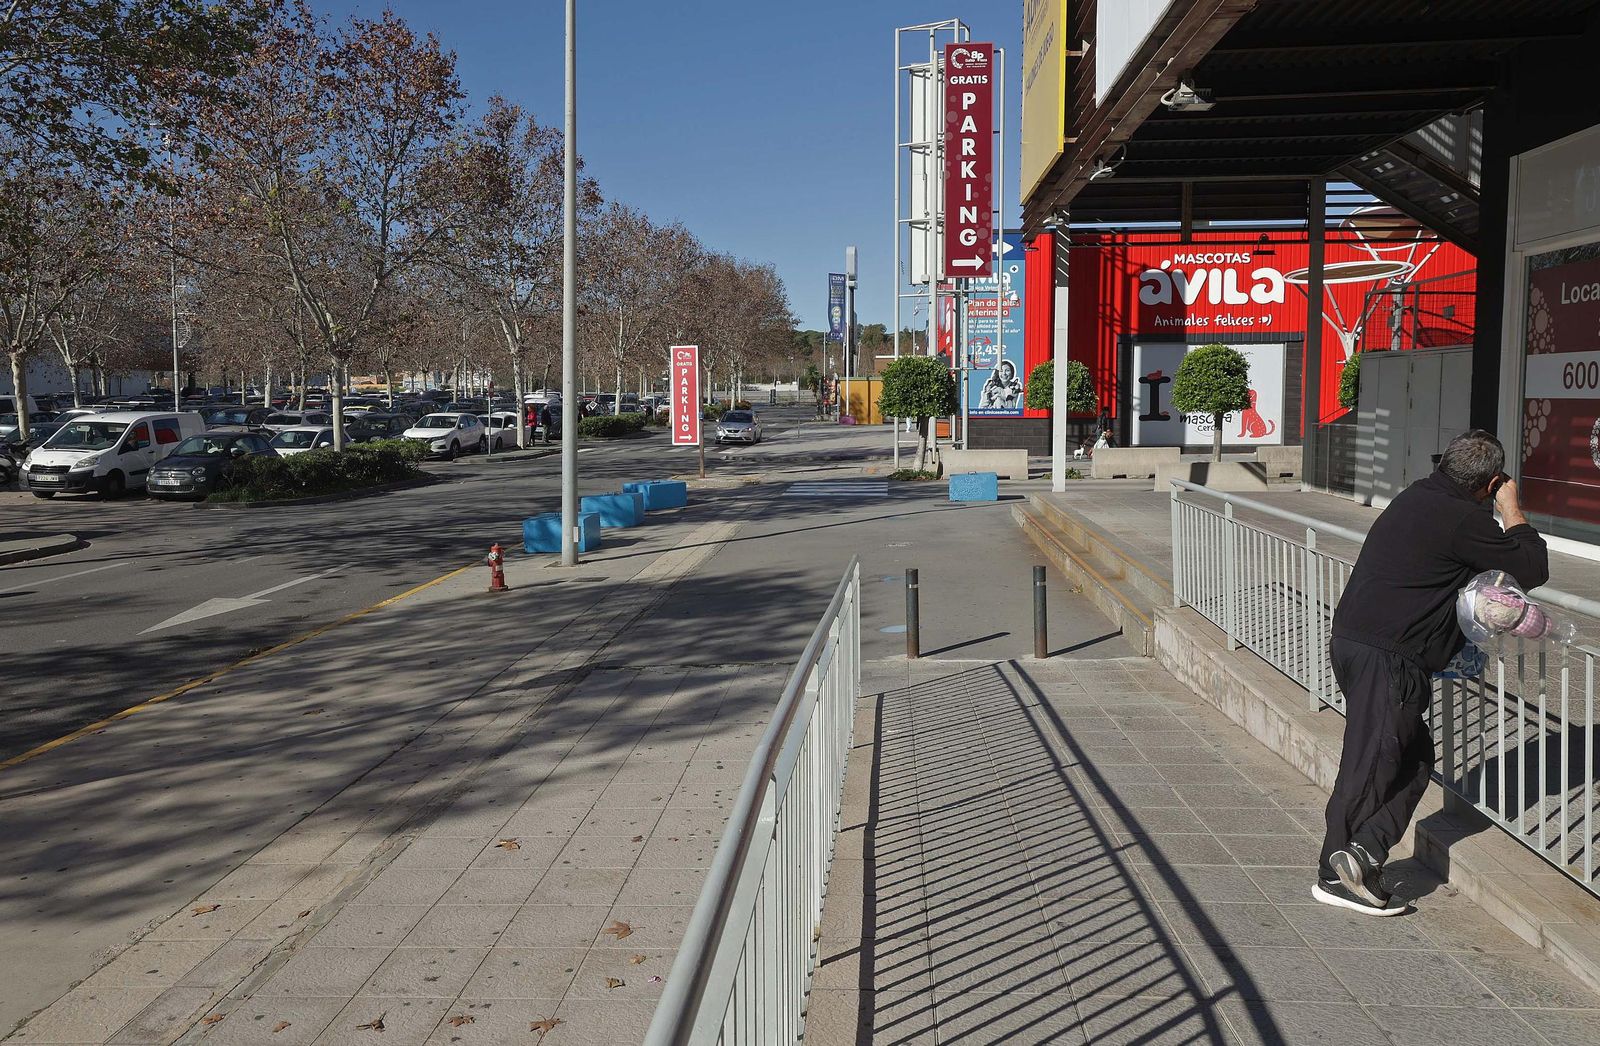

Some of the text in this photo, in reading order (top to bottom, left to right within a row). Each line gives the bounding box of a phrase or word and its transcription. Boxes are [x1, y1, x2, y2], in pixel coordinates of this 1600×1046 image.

[949, 75, 988, 85] GRATIS
[959, 92, 977, 247] PARKING
[1173, 252, 1251, 265] MASCOTAS
[986, 299, 996, 307] de
[1154, 313, 1255, 327] Animales felices
[681, 368, 690, 432] PARKING
